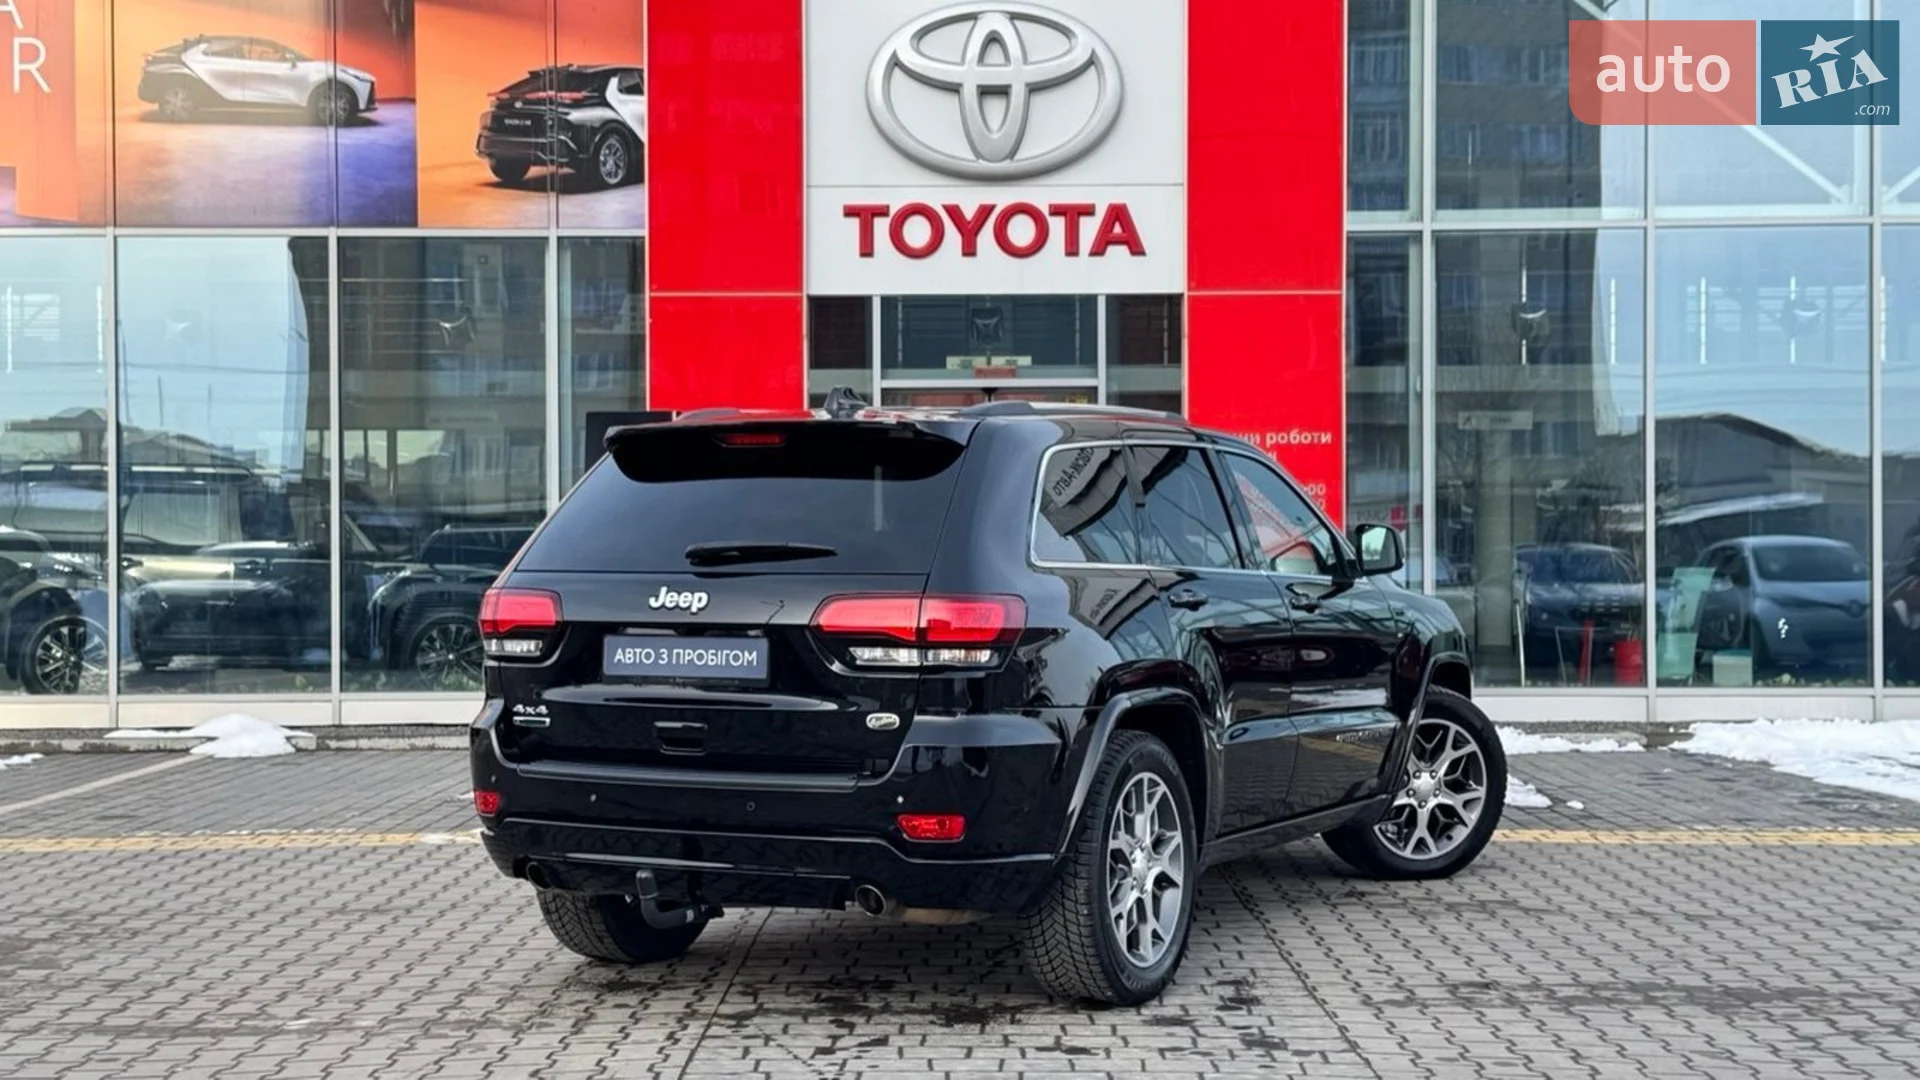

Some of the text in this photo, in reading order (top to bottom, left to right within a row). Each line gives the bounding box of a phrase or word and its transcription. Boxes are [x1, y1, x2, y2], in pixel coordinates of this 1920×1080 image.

[843, 202, 1147, 260] TOYOTA
[1265, 429, 1332, 447] роботи
[648, 586, 709, 613] Jeep
[613, 647, 656, 665] АВТО
[671, 648, 758, 667] ПРОБІГОМ
[512, 703, 549, 716] 4x4
